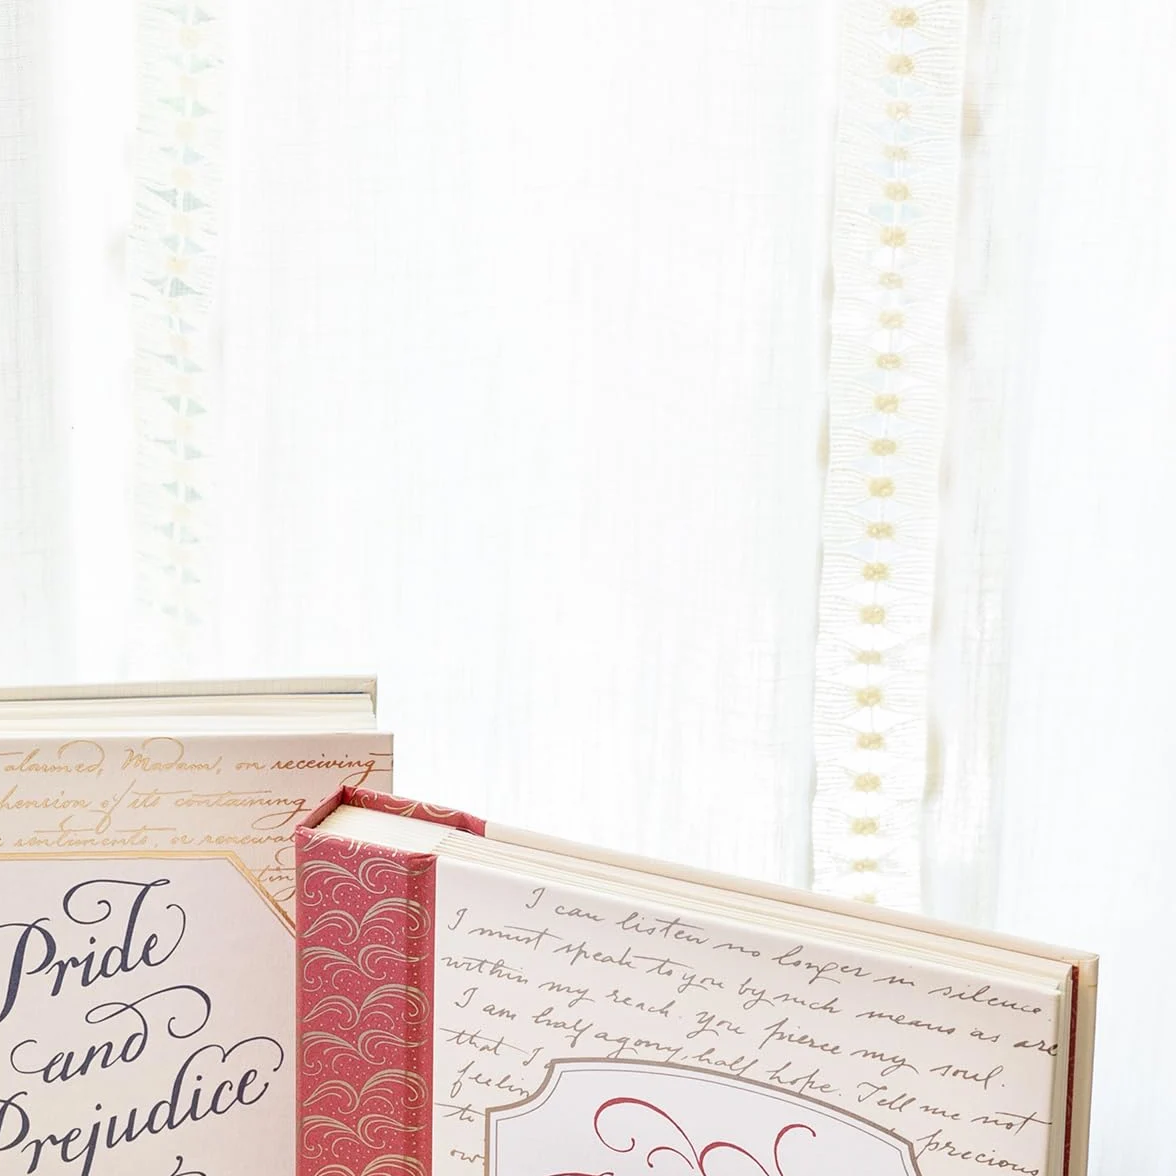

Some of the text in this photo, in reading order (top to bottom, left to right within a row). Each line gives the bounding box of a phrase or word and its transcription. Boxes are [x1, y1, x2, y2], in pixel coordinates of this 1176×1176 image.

[271, 753, 392, 787] receiving
[525, 887, 545, 908] I
[555, 904, 605, 922] can
[616, 912, 711, 945] listen
[713, 942, 760, 958] no
[772, 945, 872, 985] longer
[874, 966, 916, 987] in
[11, 985, 211, 1083] and
